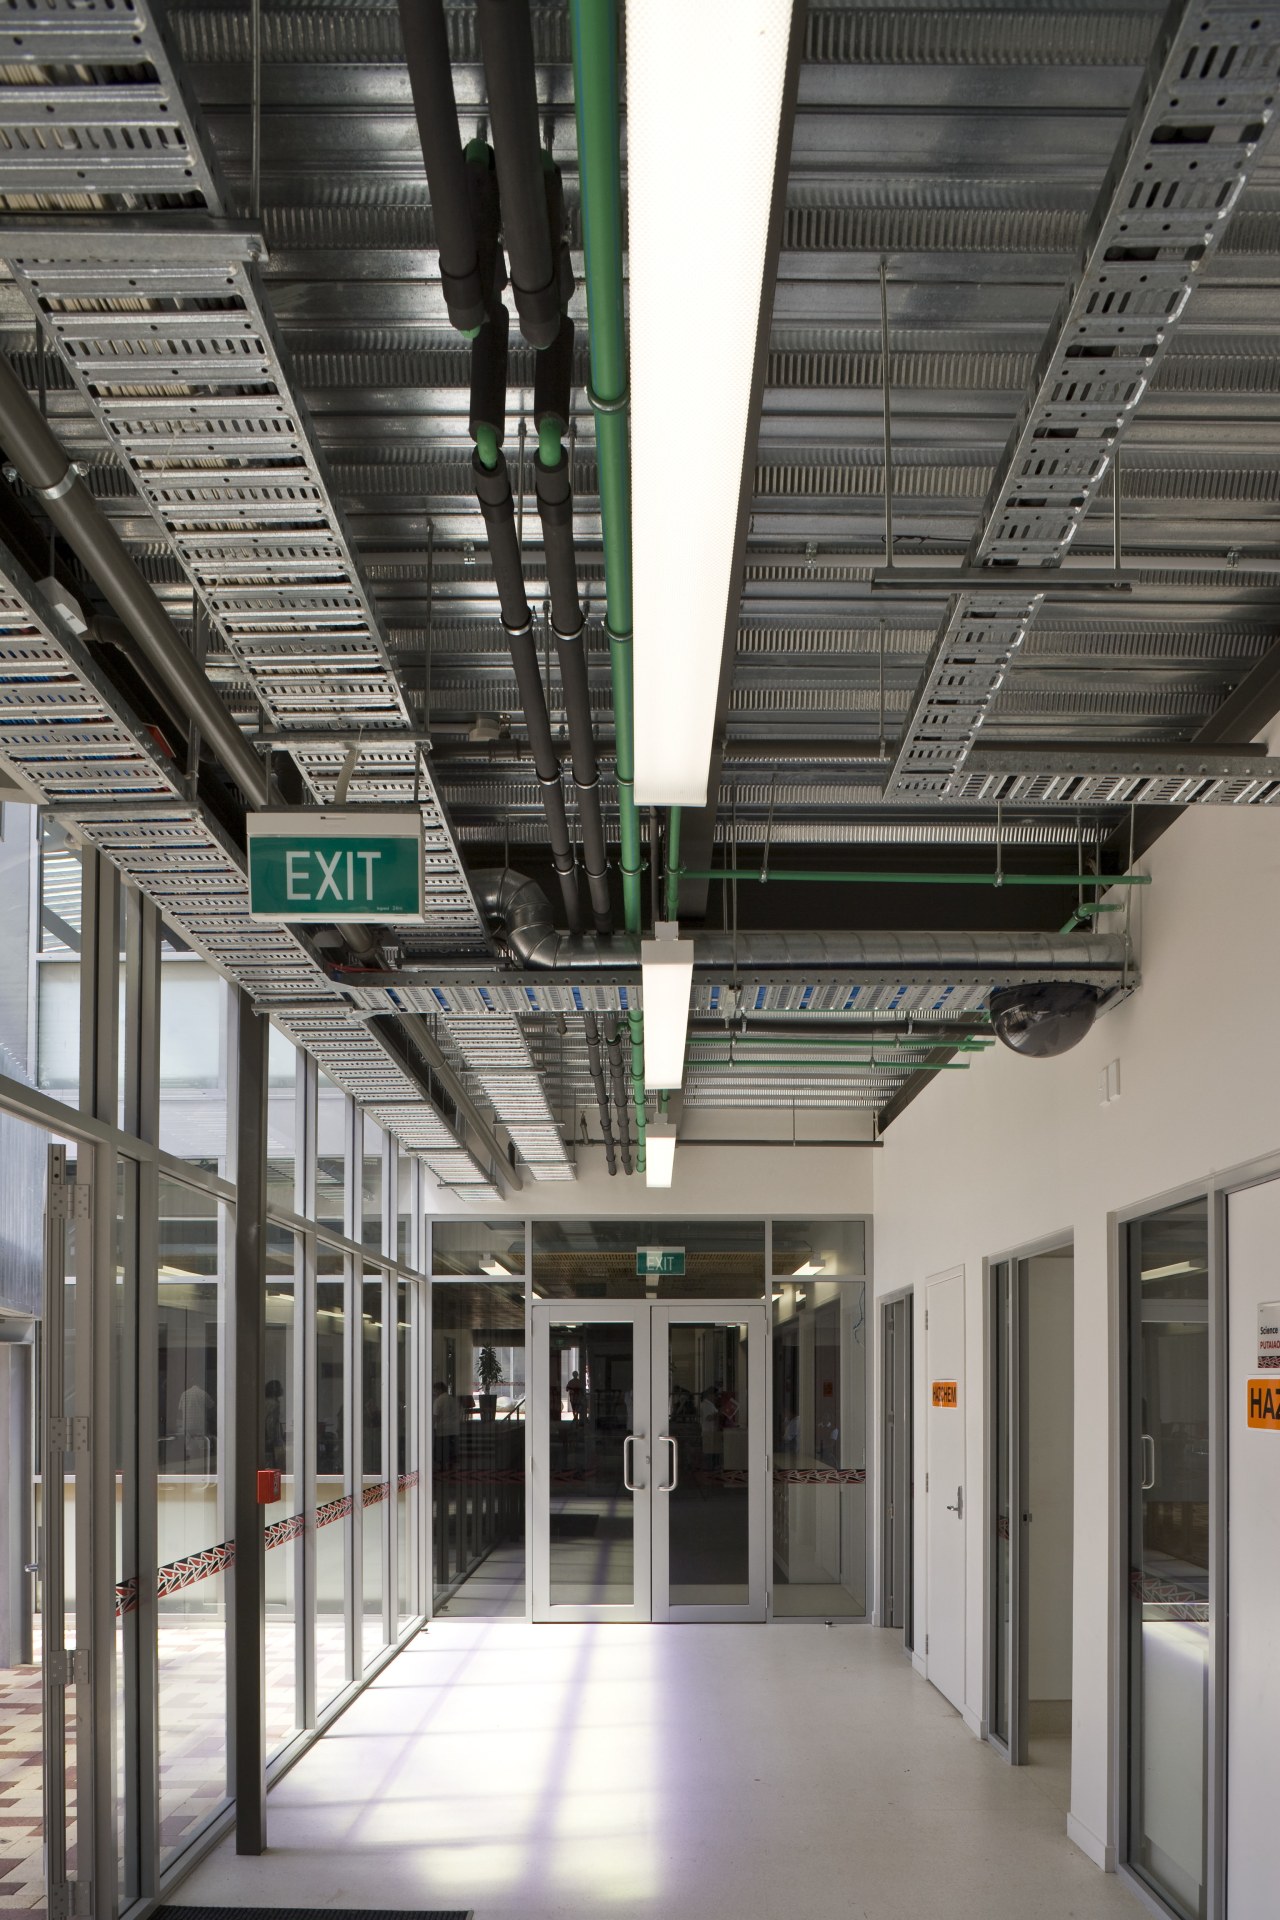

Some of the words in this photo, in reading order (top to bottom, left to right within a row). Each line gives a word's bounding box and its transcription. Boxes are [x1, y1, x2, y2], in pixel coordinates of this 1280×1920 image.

[285, 851, 382, 901] EXIT
[647, 1256, 675, 1271] EXIT
[1260, 1326, 1279, 1335] Science
